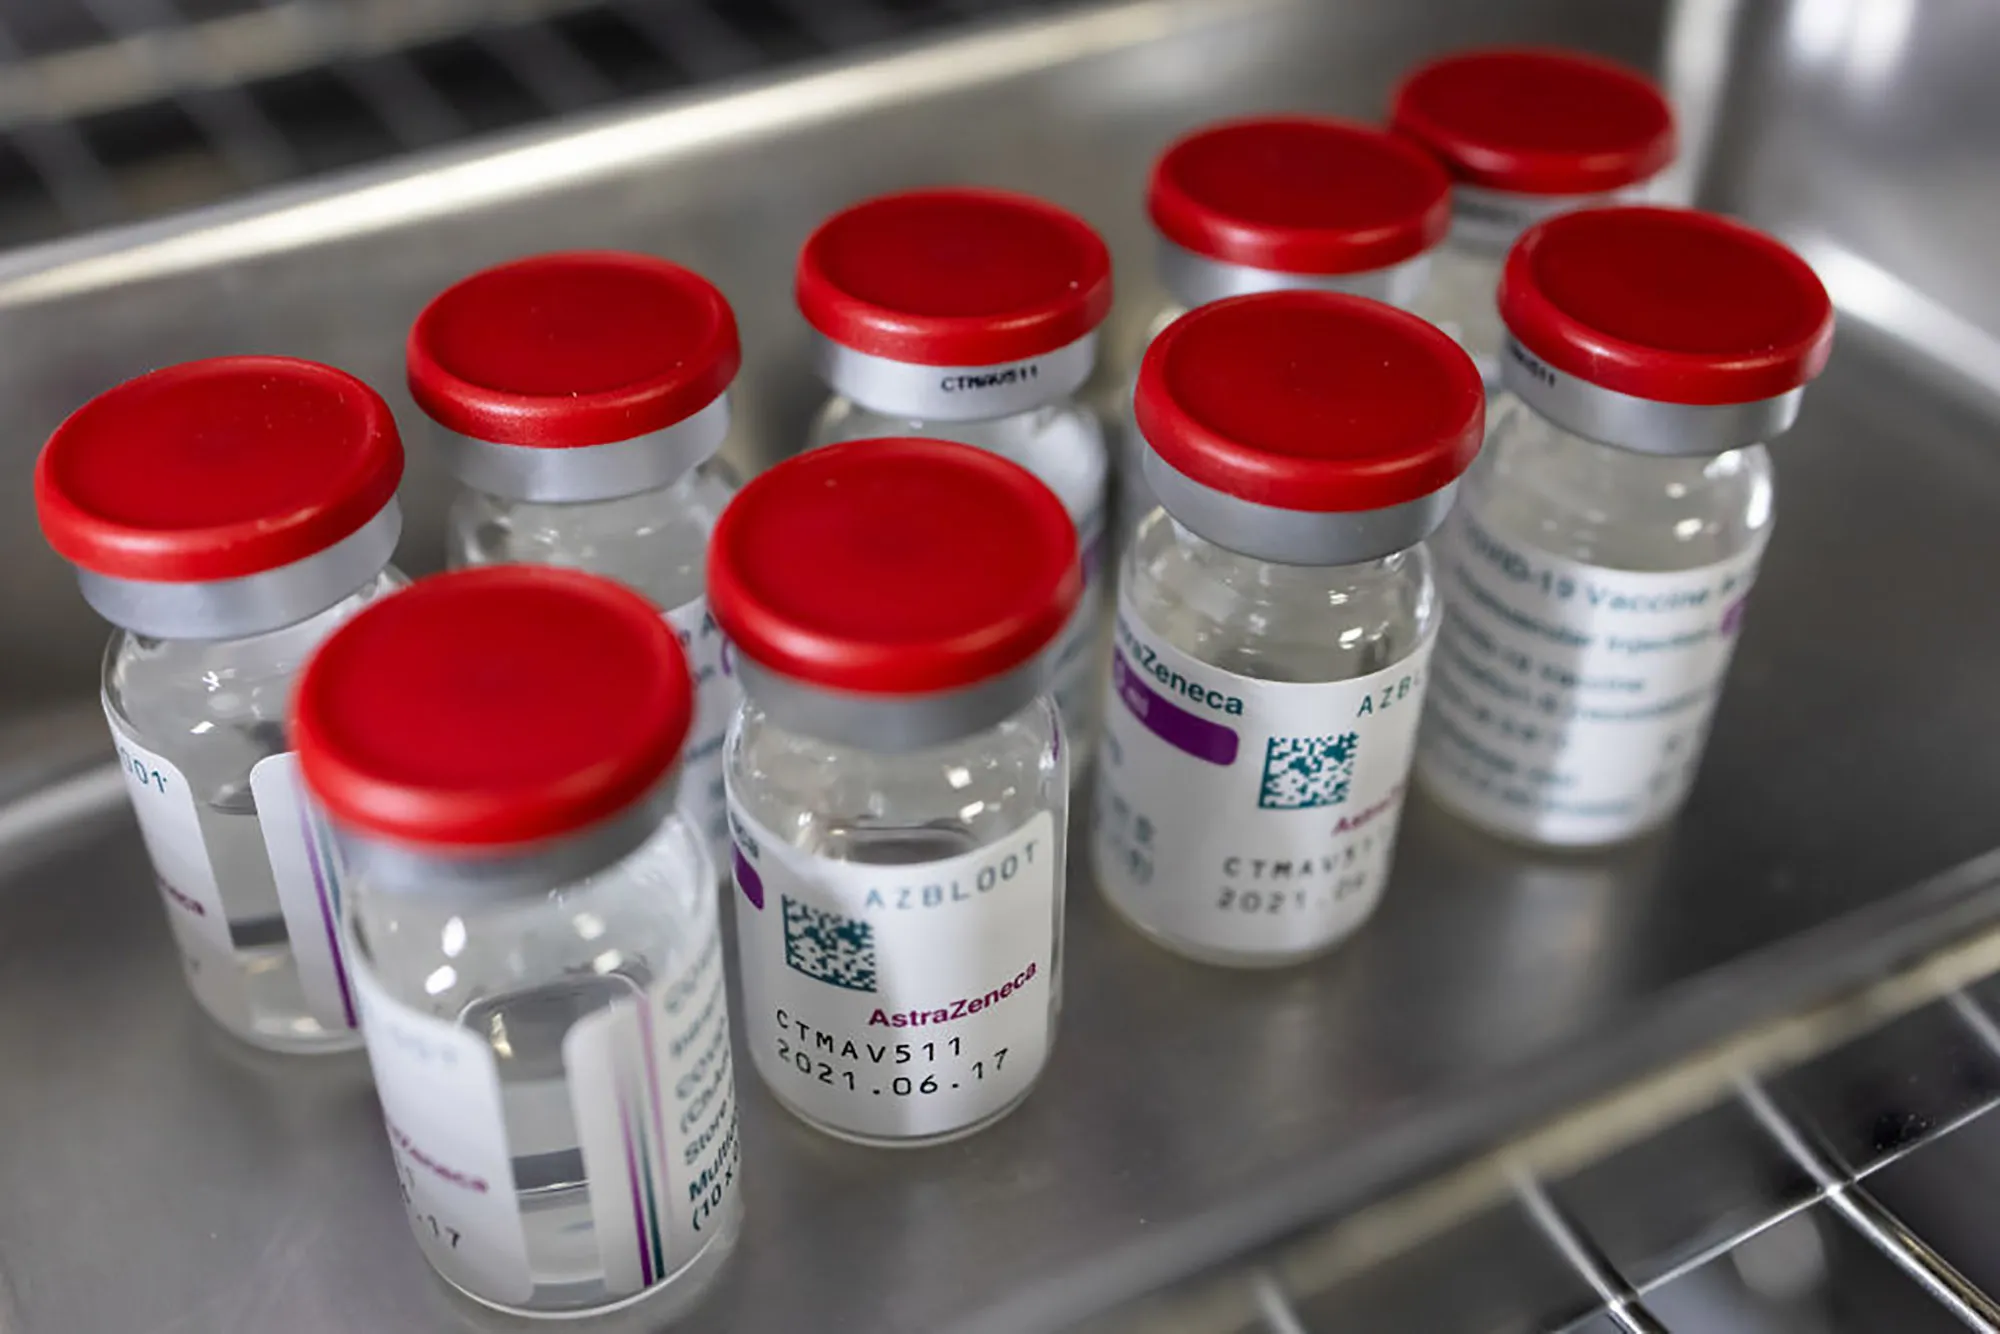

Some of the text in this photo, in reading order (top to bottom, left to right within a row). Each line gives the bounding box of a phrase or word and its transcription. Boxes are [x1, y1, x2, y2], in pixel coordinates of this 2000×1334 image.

[868, 962, 1037, 1028] AstraZeneca
[776, 1008, 960, 1065] CTMAV511
[776, 1037, 1008, 1096] 2021.06.17
